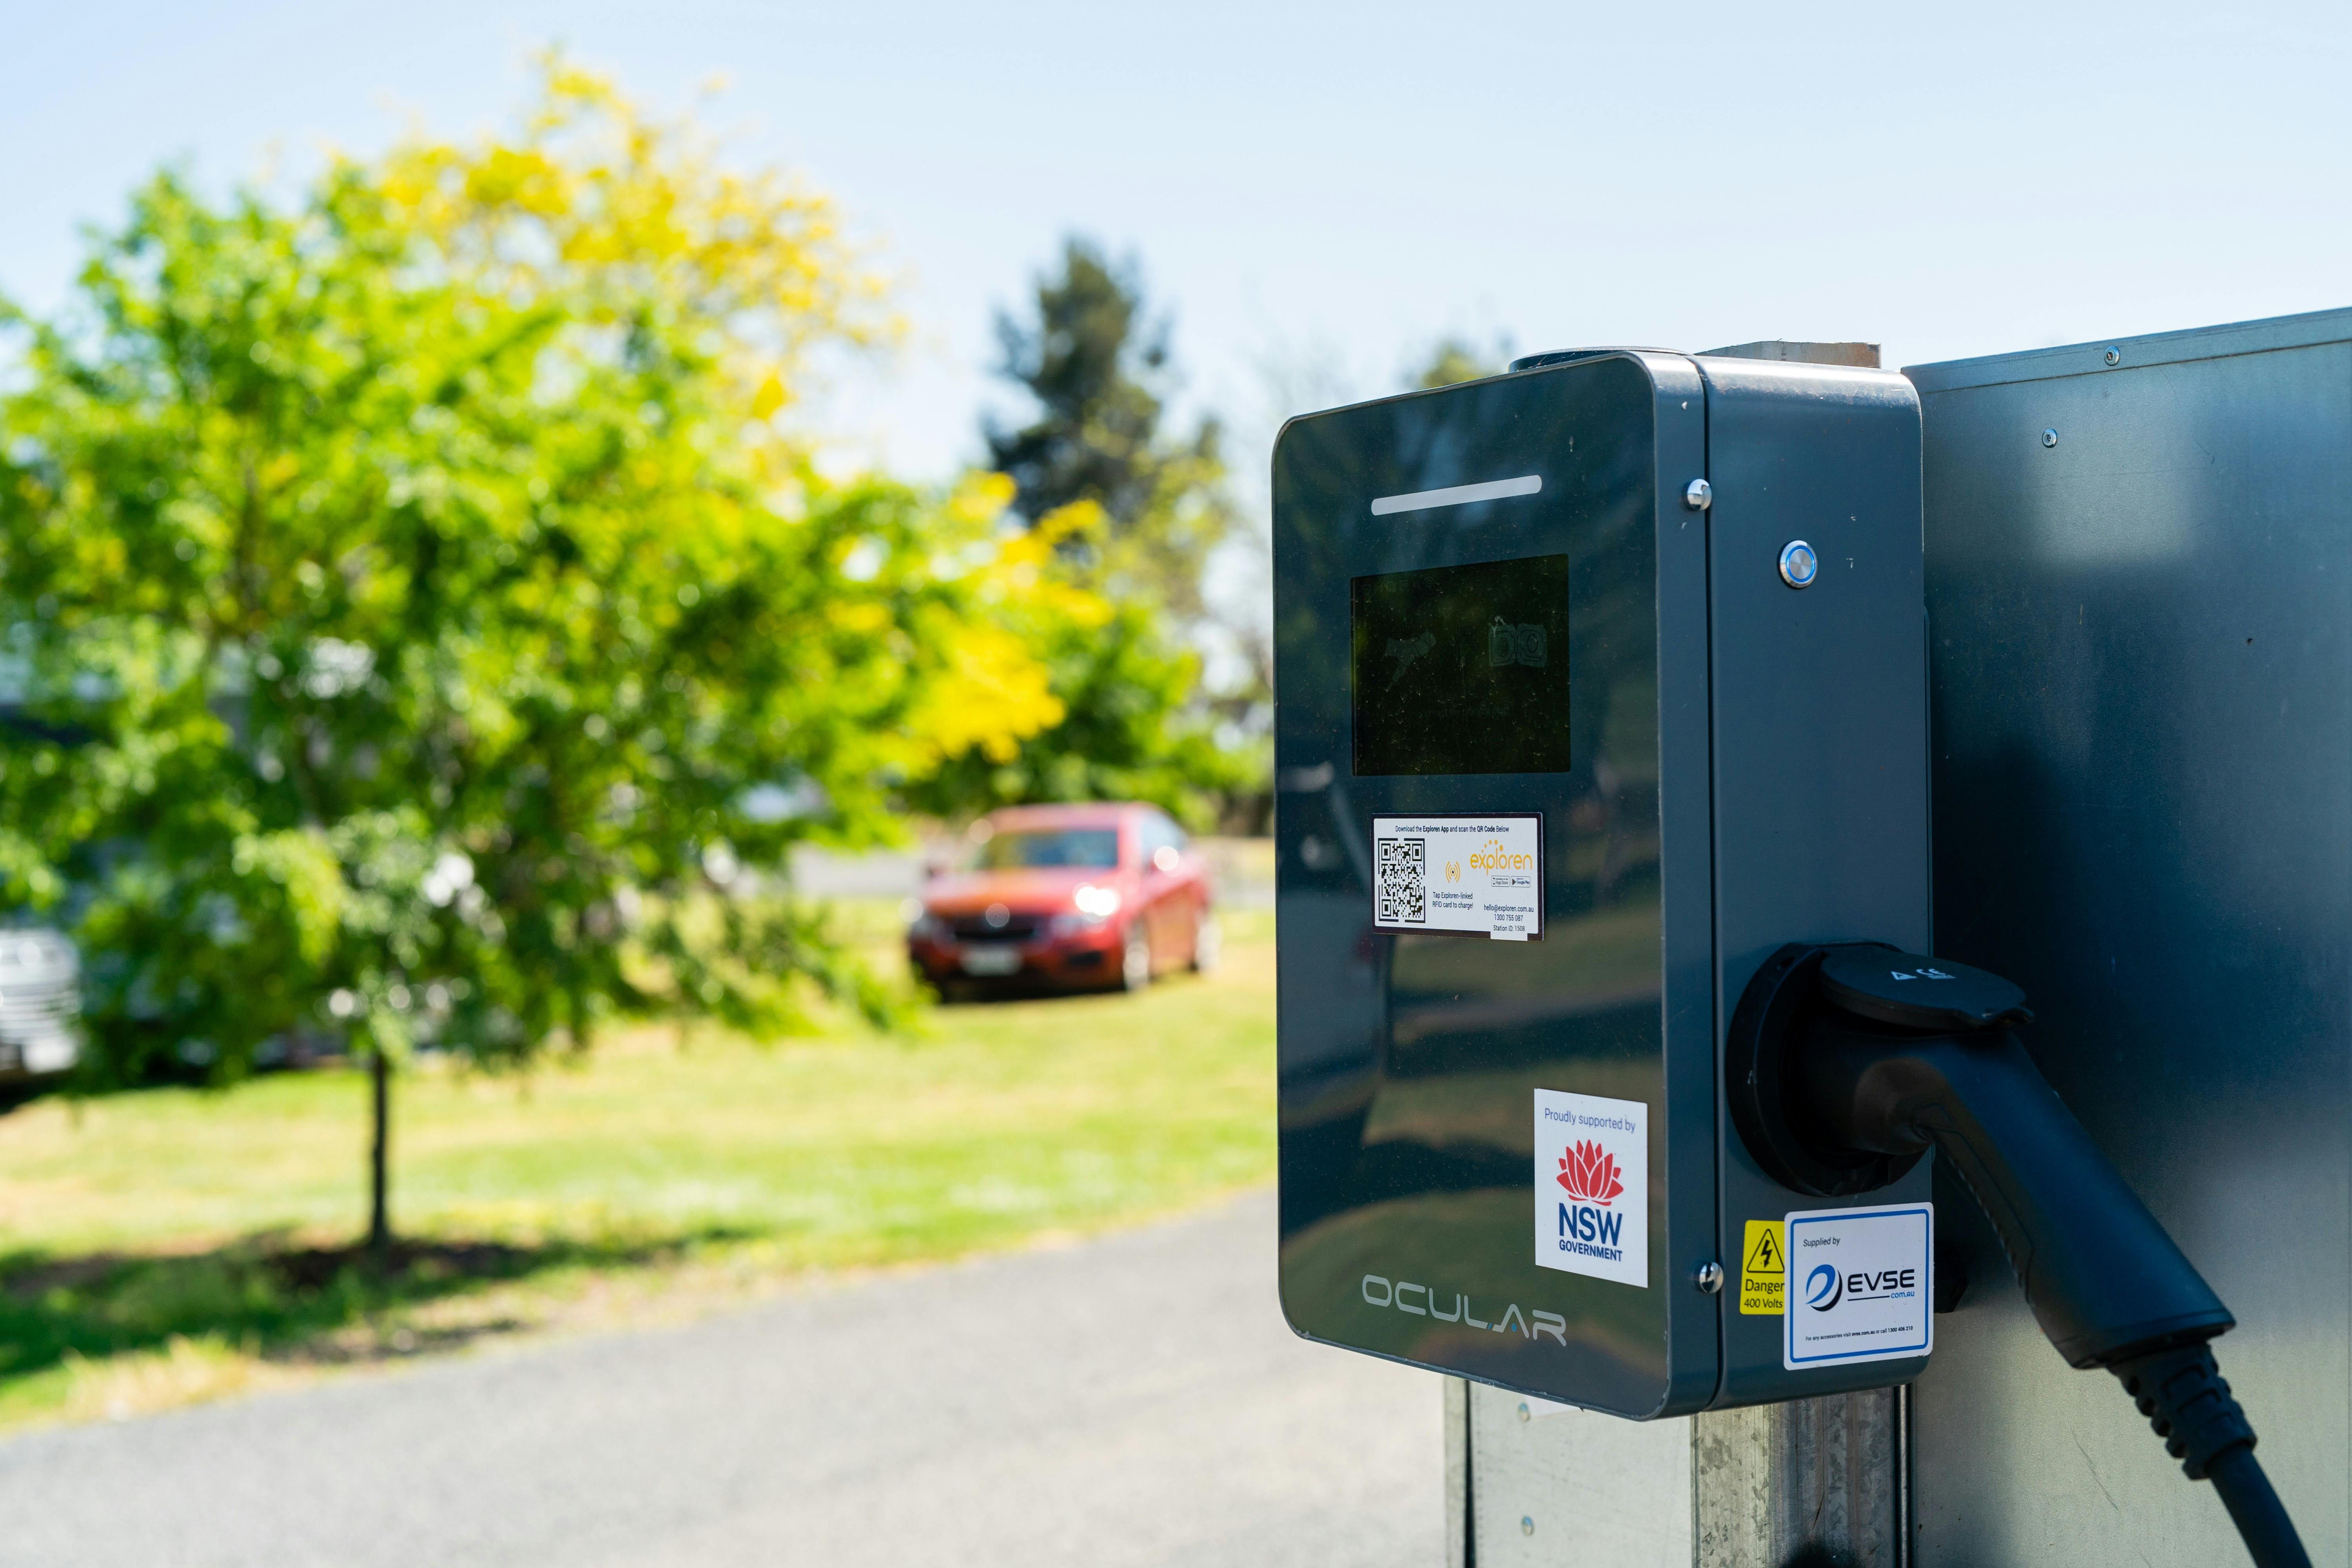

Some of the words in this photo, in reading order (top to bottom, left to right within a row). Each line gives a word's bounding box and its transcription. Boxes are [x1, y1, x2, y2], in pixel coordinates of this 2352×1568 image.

[1423, 825, 1440, 833] Exploren
[1470, 847, 1532, 876] exploren
[1458, 902, 1474, 910] charge!
[1484, 904, 1534, 912] hello@exploren.com.au
[1545, 1108, 1576, 1125] Proudly
[1579, 1115, 1622, 1130] supported
[1625, 1118, 1636, 1134] by
[1559, 1202, 1622, 1247] NSW
[1559, 1239, 1622, 1262] GOVERNMENT
[1803, 1237, 1831, 1248] Supplied
[1833, 1236, 1840, 1246] by
[1745, 1279, 1785, 1294] Danger
[1847, 1269, 1915, 1293] EVSE
[1362, 1274, 1566, 1347] OCULAR
[1744, 1298, 1760, 1308] 400
[1762, 1298, 1783, 1308] Volts
